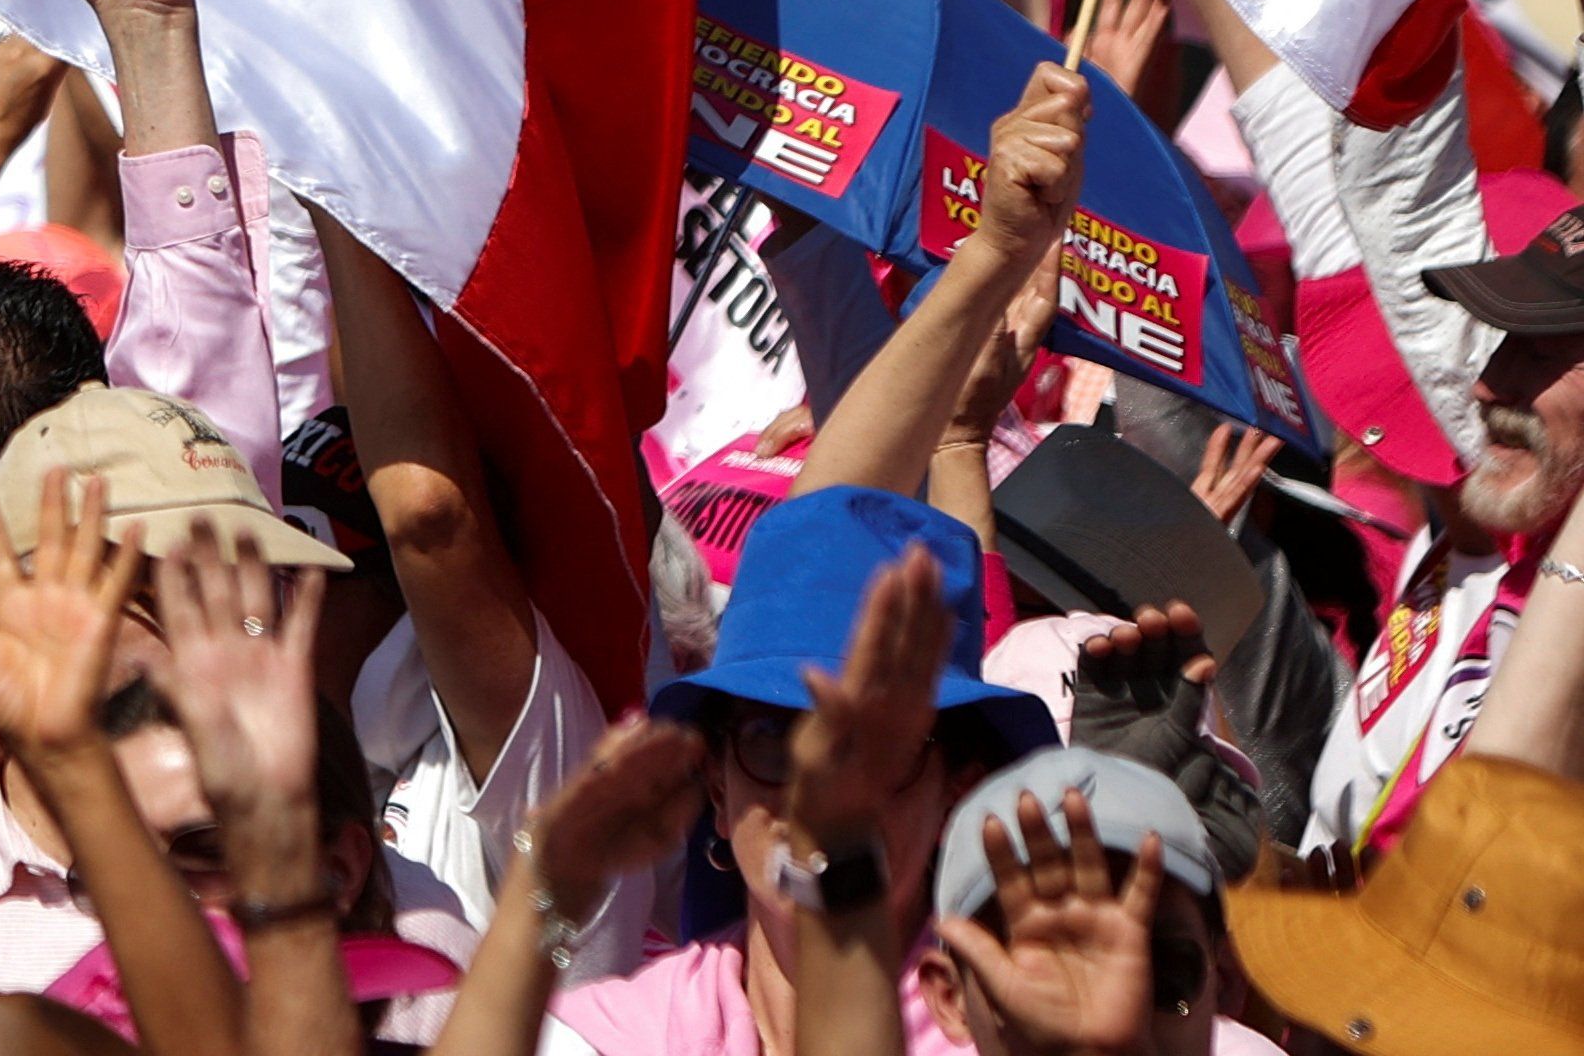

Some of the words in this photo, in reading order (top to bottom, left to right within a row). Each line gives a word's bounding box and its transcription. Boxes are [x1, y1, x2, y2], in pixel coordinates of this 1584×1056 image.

[795, 117, 843, 149] AL
[942, 167, 979, 203] LA
[1142, 294, 1180, 327] AL
